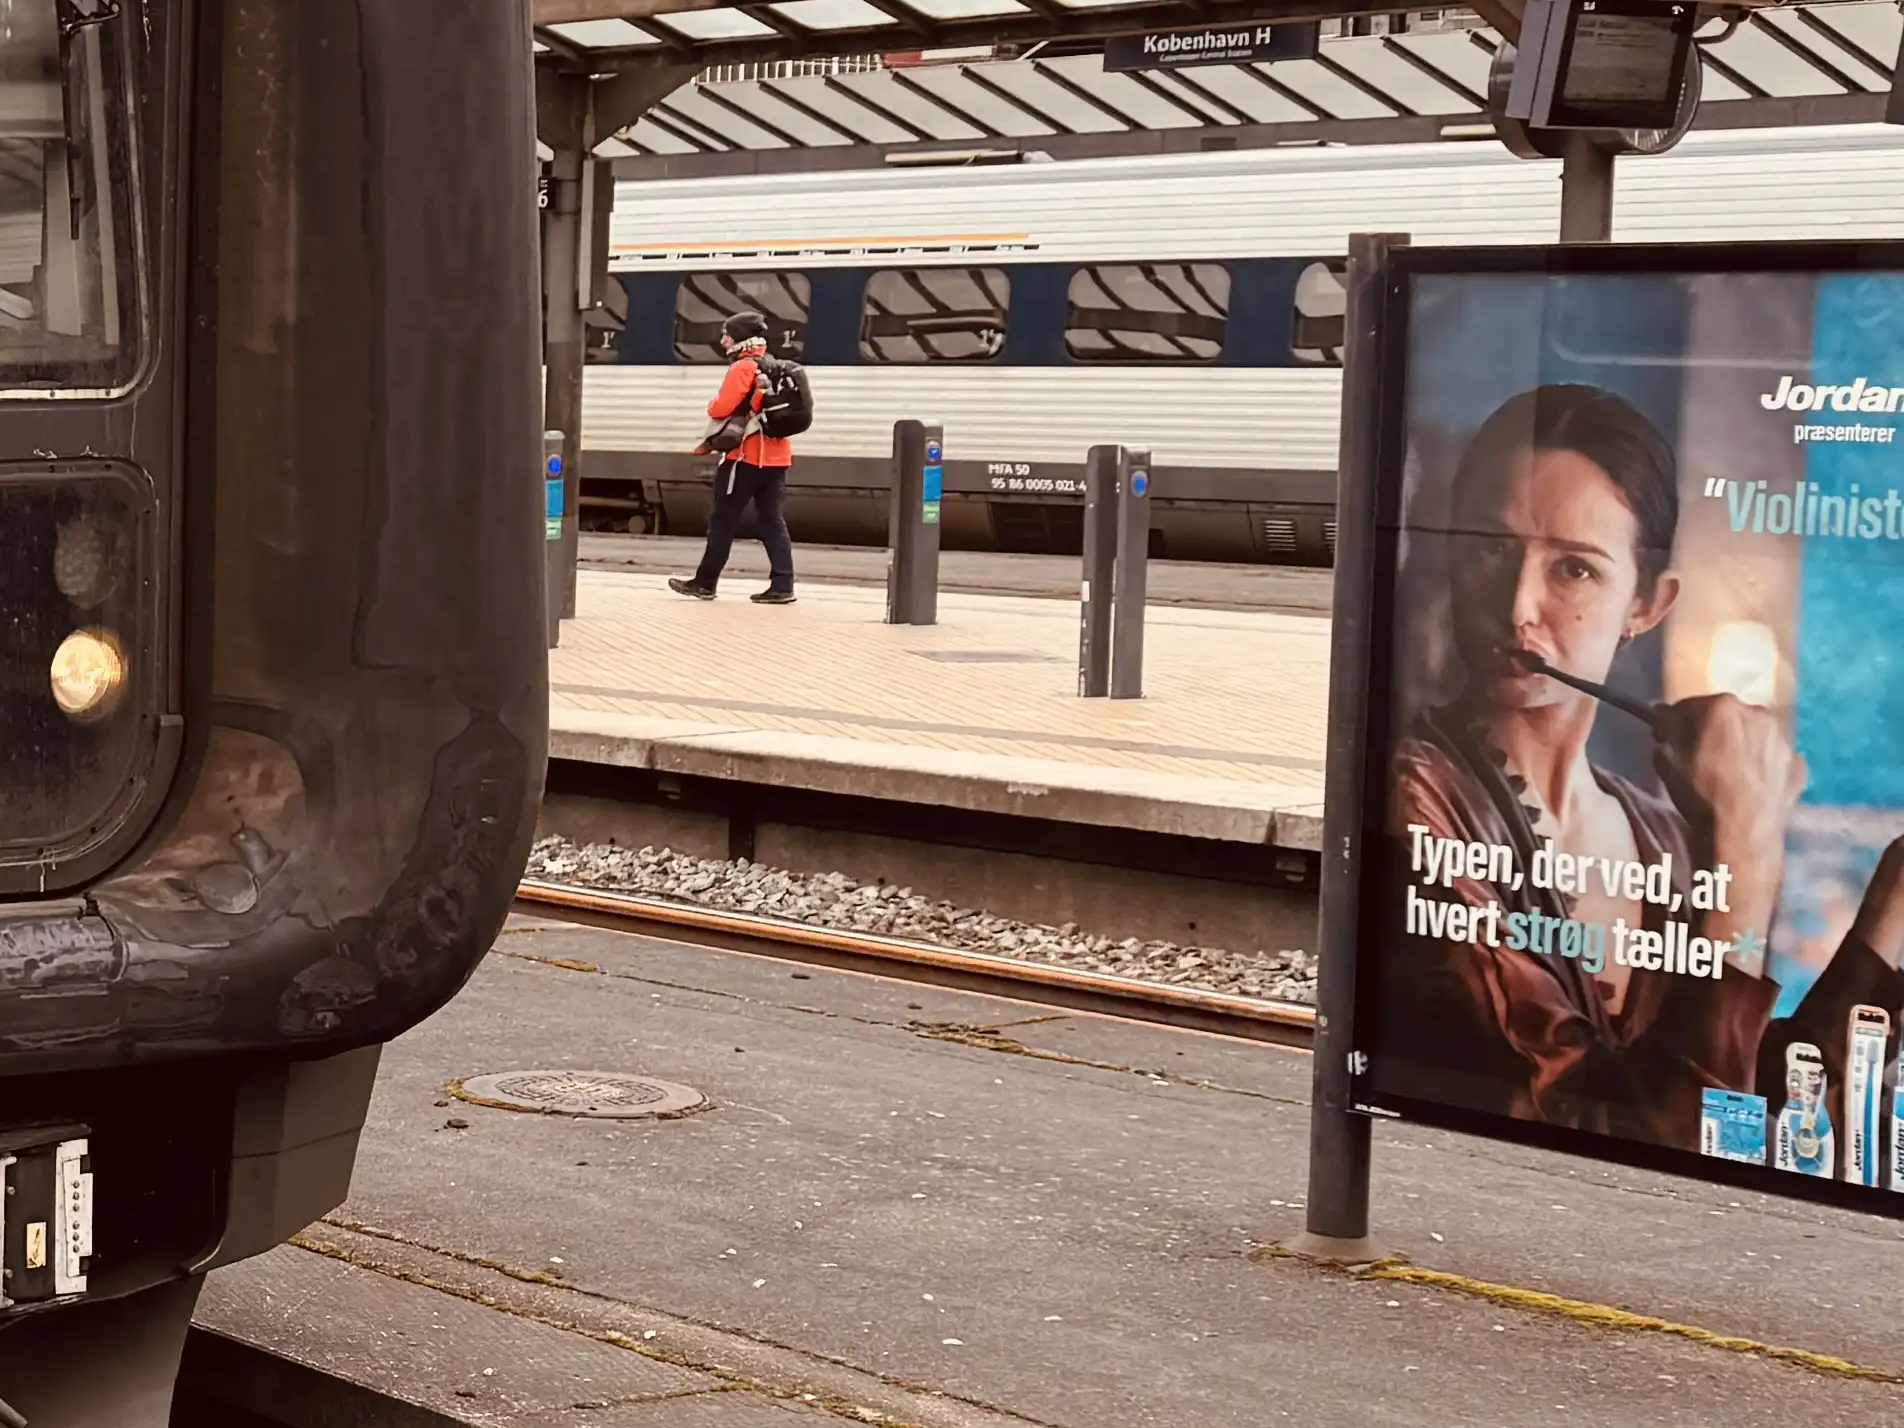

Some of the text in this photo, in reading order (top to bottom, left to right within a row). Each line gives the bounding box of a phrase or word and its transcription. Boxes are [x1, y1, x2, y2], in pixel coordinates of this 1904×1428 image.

[1144, 26, 1272, 53] København H
[1794, 422, 1896, 444] præsenterer
[1407, 823, 1732, 914] Typen, der ved, at
[1406, 885, 1502, 948] hvert
[1505, 906, 1605, 973] strøg
[1777, 1120, 1791, 1166] Jordan
[1852, 1128, 1865, 1171] Jordan
